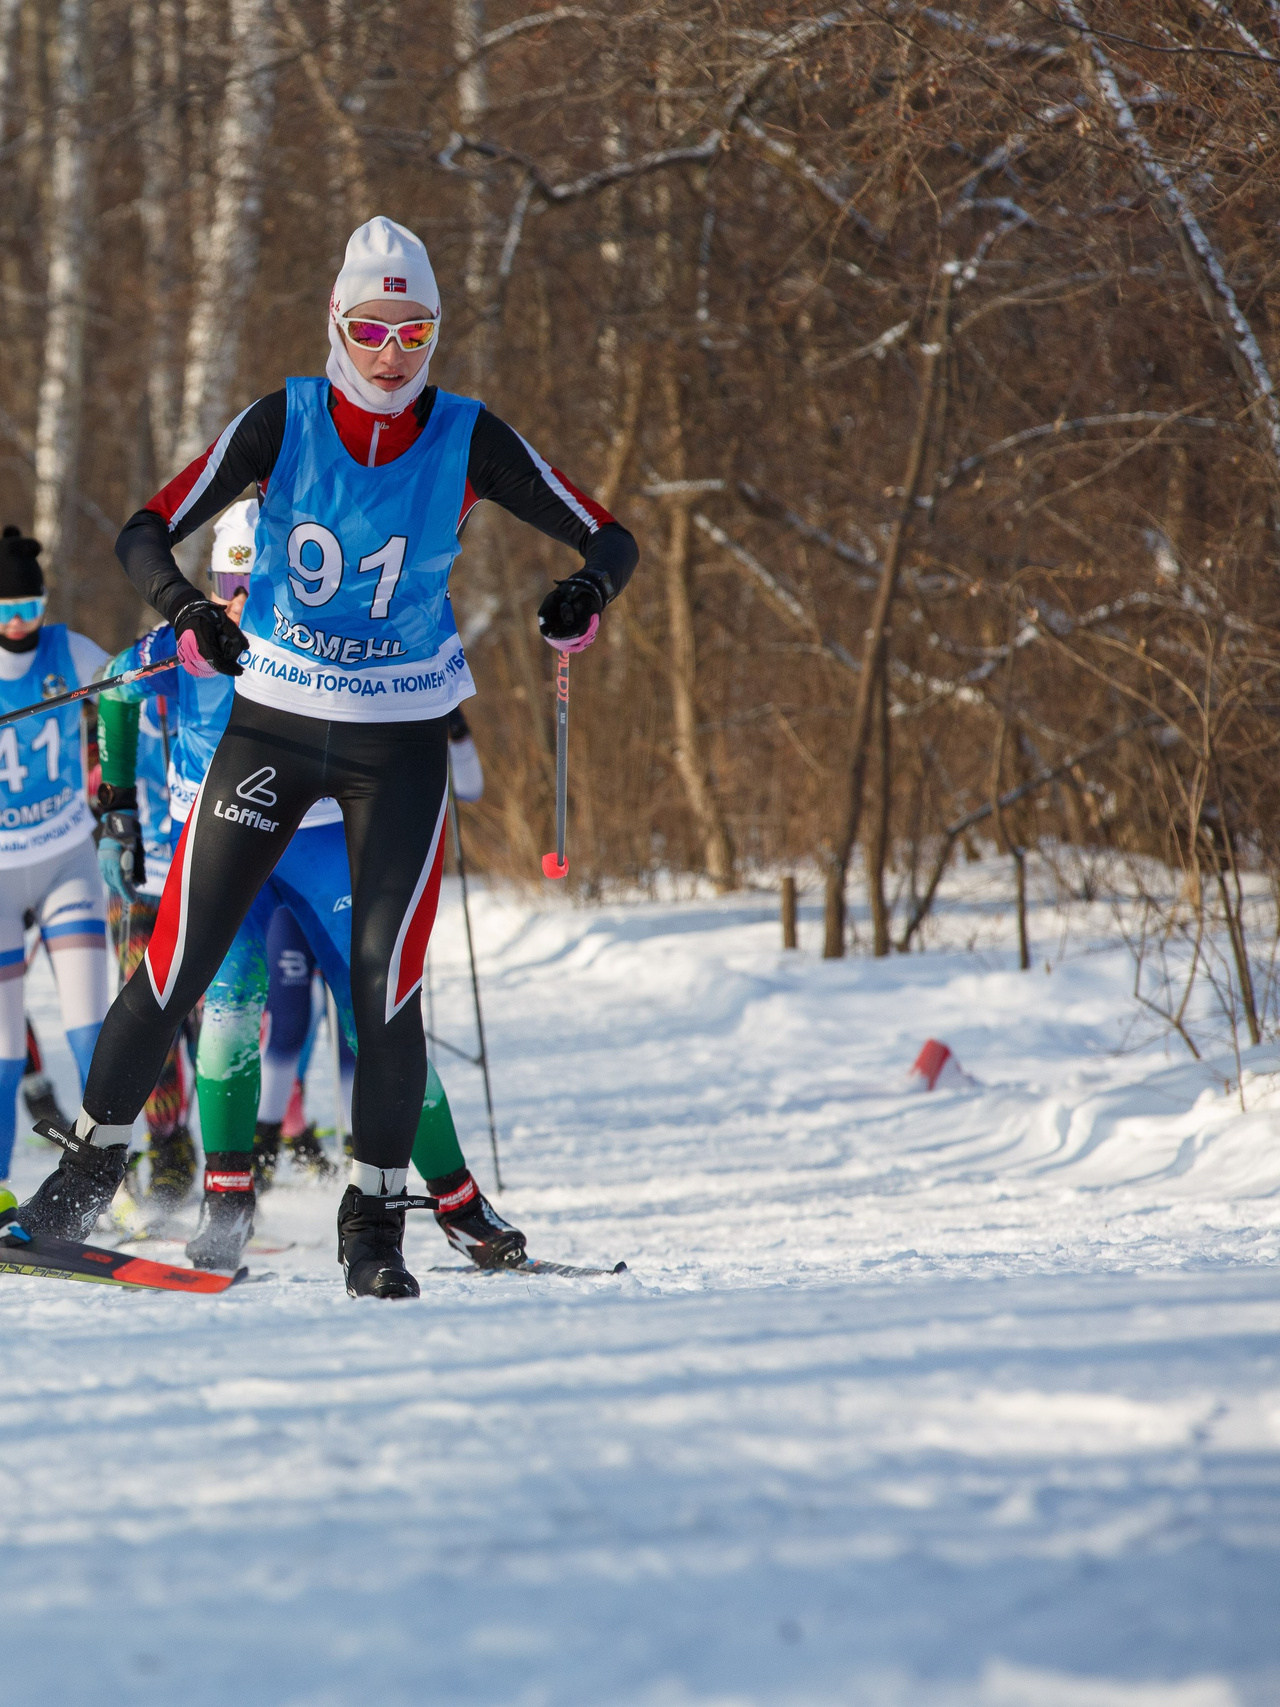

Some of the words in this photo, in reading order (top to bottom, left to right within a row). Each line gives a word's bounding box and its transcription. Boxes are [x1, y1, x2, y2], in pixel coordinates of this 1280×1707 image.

[287, 521, 410, 620] 91
[259, 657, 312, 688] ГЛАВЫ
[316, 674, 388, 697] ГОРОДА
[214, 800, 280, 832] Löffler
[47, 1127, 80, 1153] SPINE
[384, 1199, 426, 1210] SPINE
